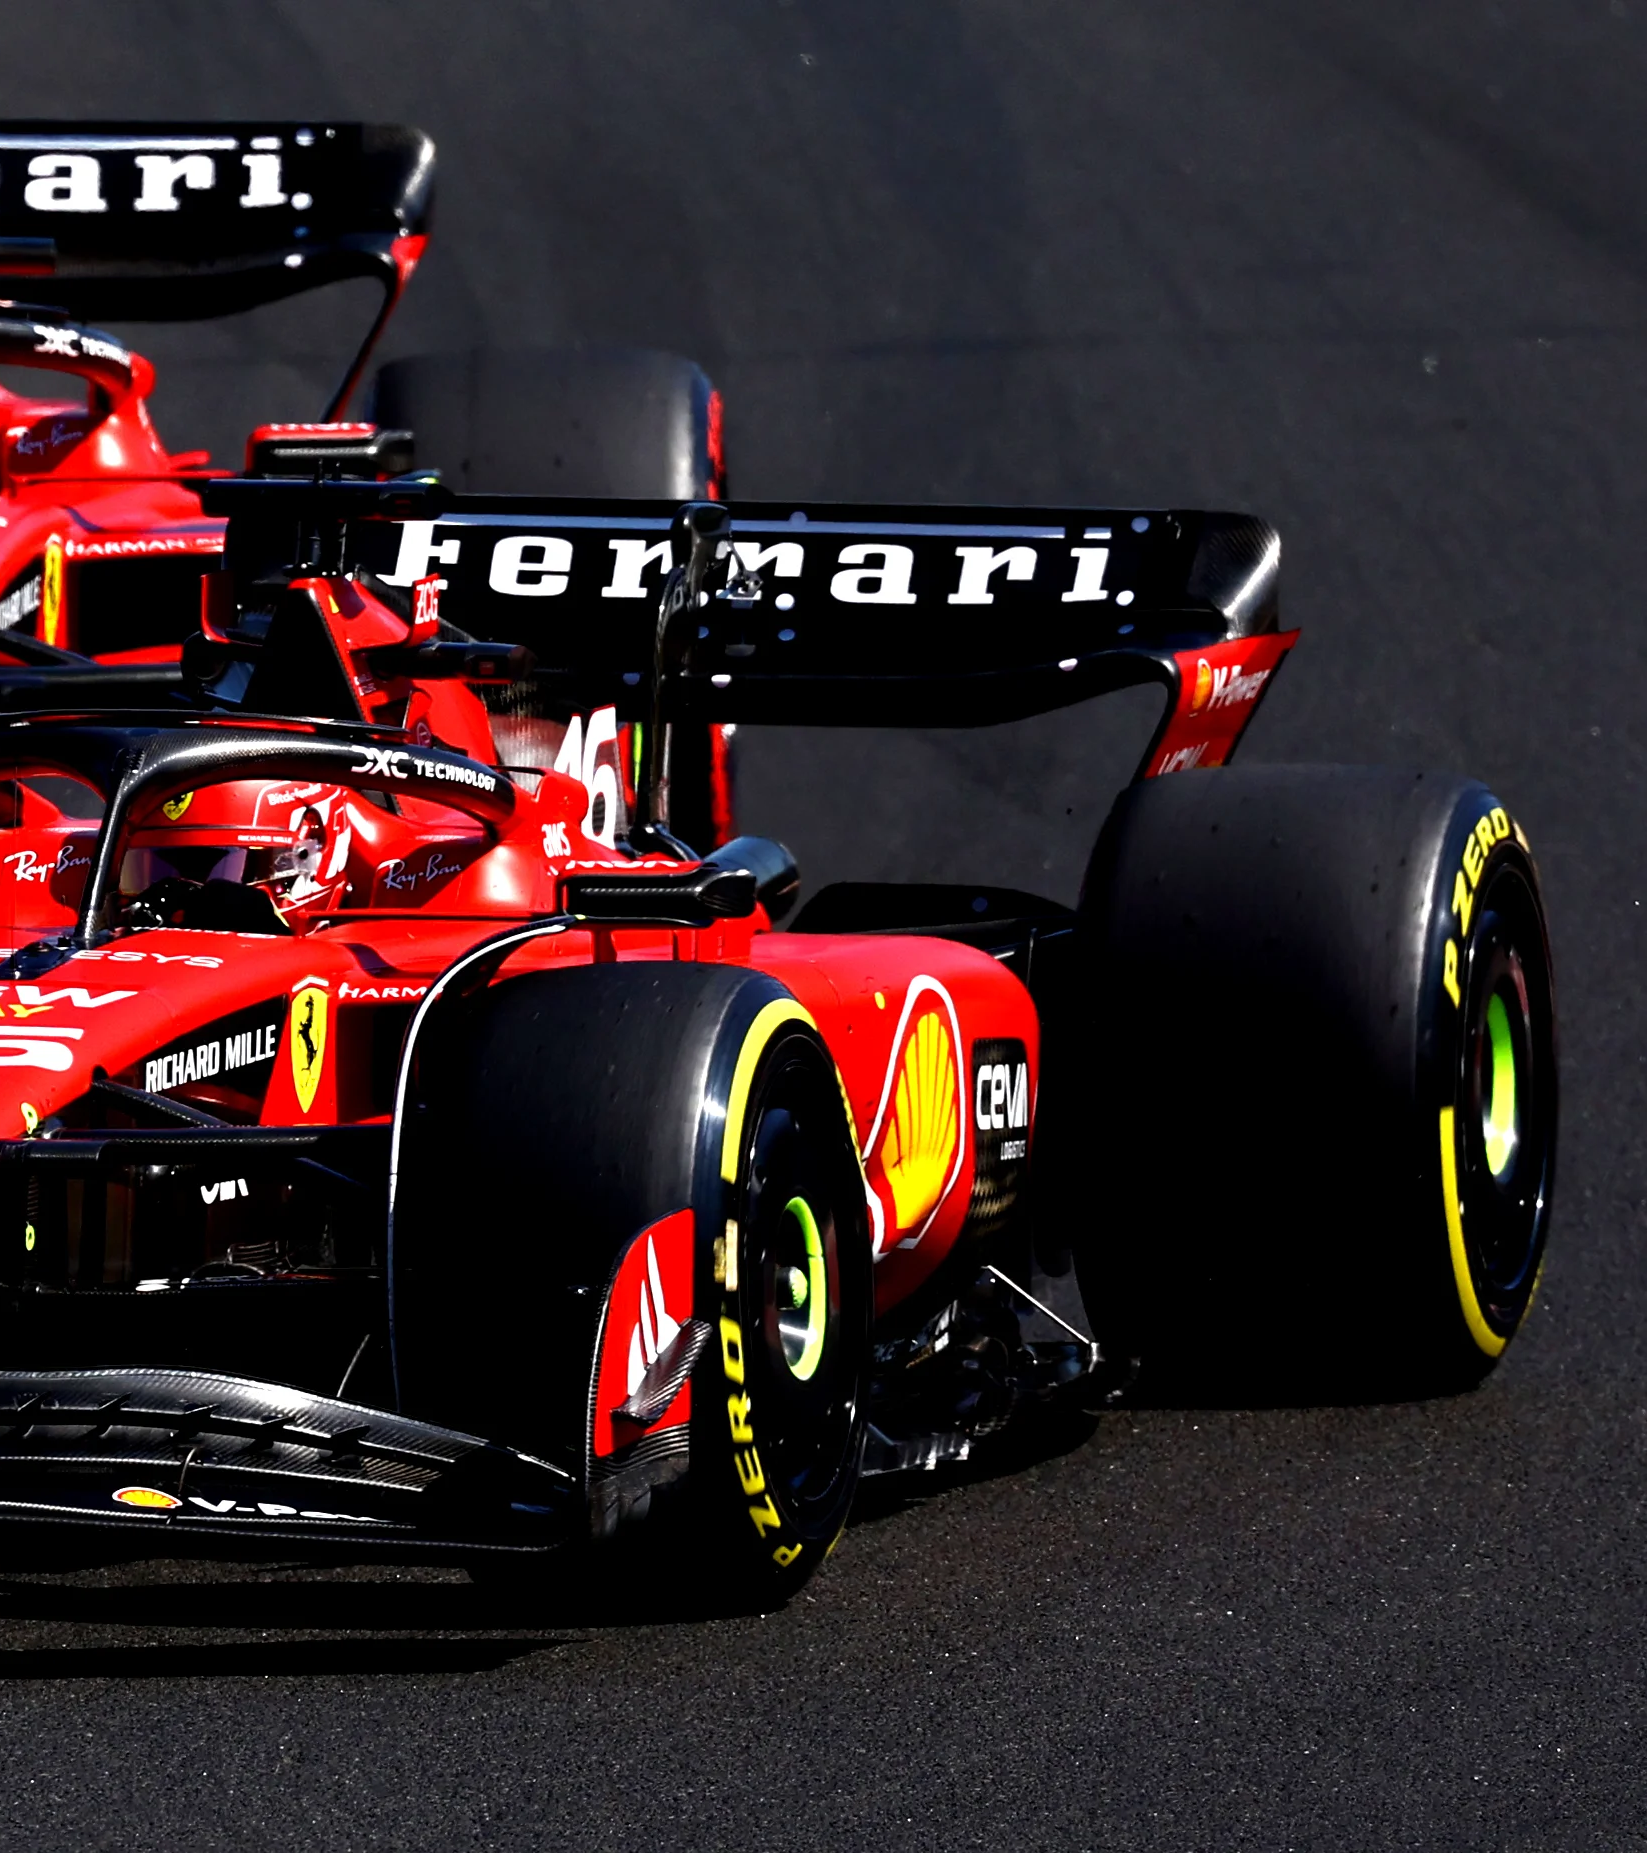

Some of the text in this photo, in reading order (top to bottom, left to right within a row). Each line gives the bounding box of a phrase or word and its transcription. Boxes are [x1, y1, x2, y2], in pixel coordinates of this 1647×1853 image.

[375, 518, 1112, 603] Ferrari
[415, 580, 439, 625] ZCG
[351, 746, 497, 793] DXC TECHNOLOGY
[553, 706, 617, 851] 16
[4, 846, 92, 883] Ray-Ban
[377, 853, 462, 891] Ray-Ban
[1443, 806, 1511, 1010] P ZERO
[145, 1023, 277, 1093] RICHARD MILLE
[719, 1315, 782, 1539] ZERO
